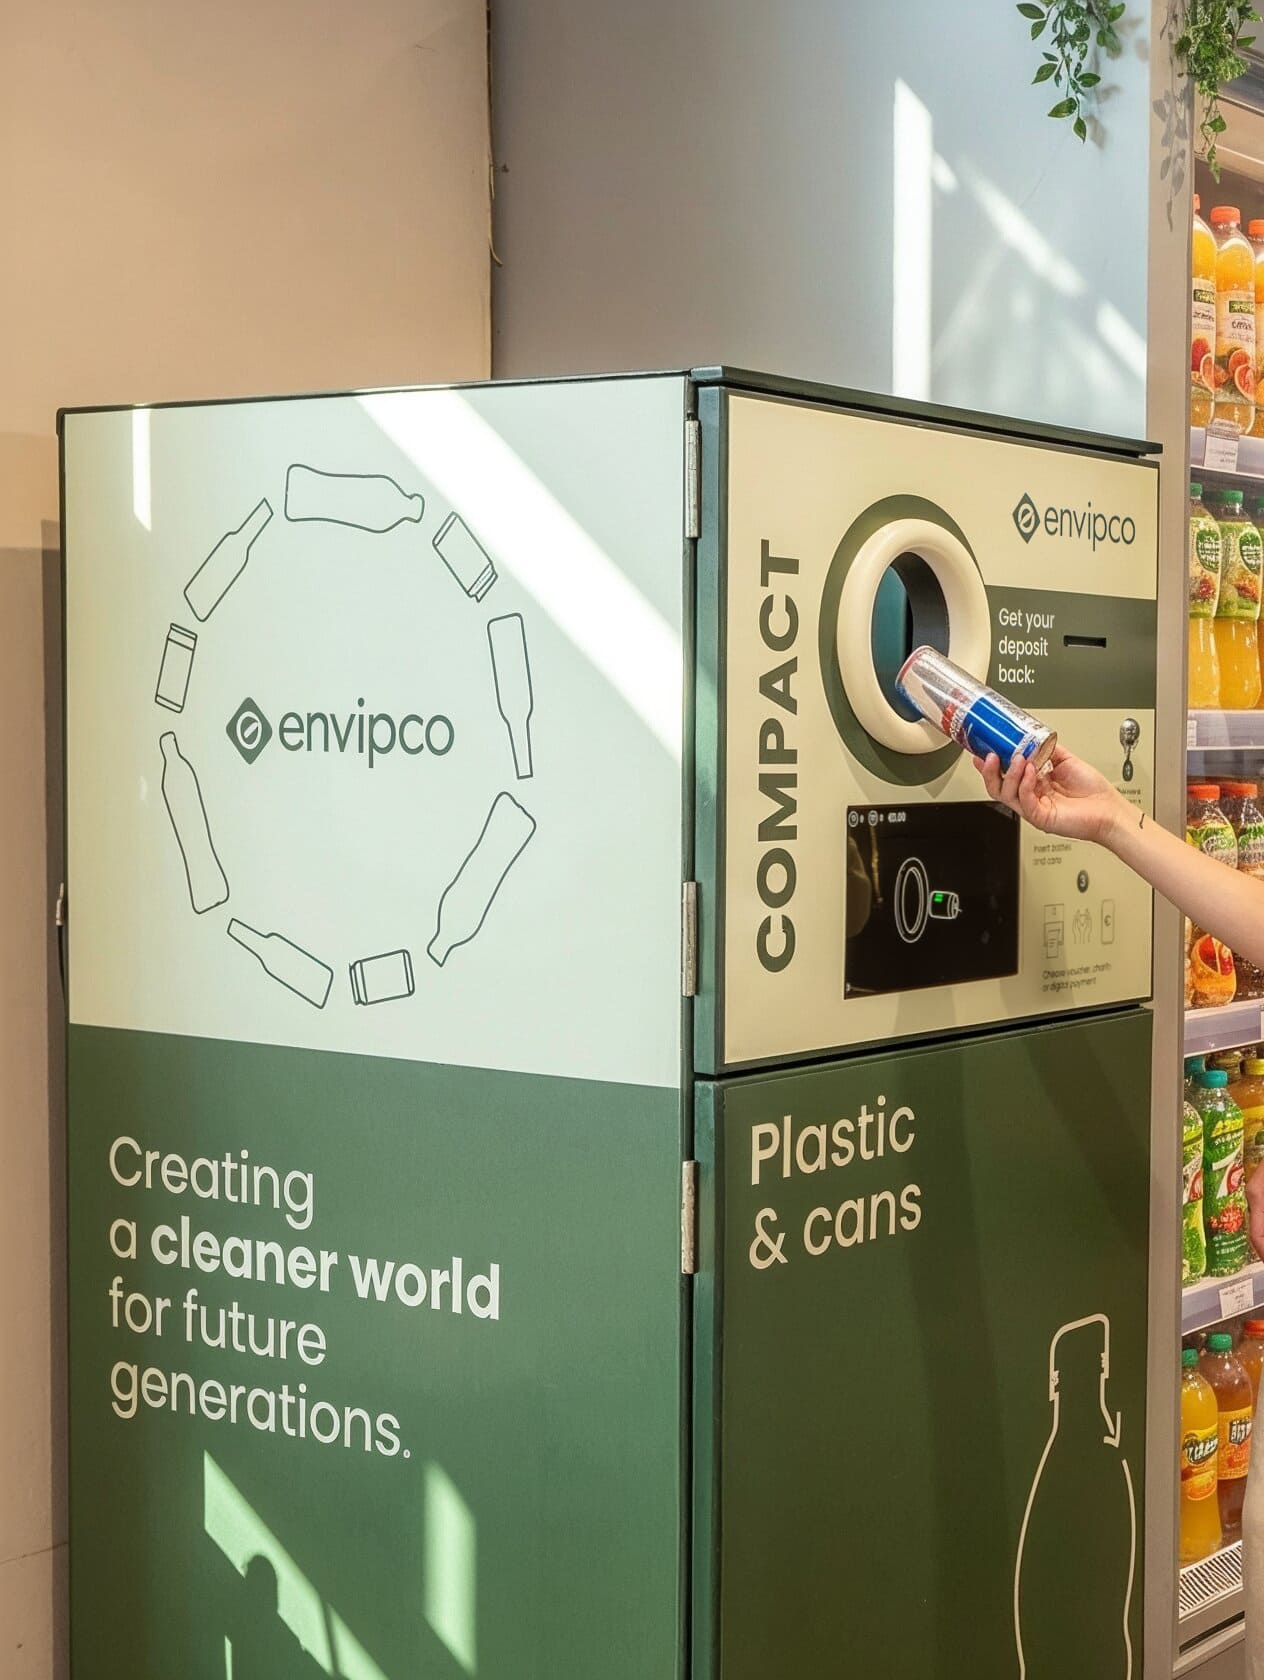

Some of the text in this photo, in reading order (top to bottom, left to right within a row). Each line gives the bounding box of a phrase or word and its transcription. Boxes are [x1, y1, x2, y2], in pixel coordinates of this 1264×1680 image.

[1044, 501, 1136, 552] envipco
[998, 607, 1055, 634] Get your
[998, 635, 1049, 661] deposit
[998, 663, 1035, 684] back:
[278, 697, 455, 769] envipco
[756, 538, 800, 974] COMPACT
[109, 1136, 314, 1231] Creating
[751, 1094, 917, 1187] Plastic
[109, 1215, 500, 1321] a cleaner world
[749, 1183, 922, 1271] & cans
[108, 1275, 328, 1366] for future
[110, 1360, 411, 1460] generations.
